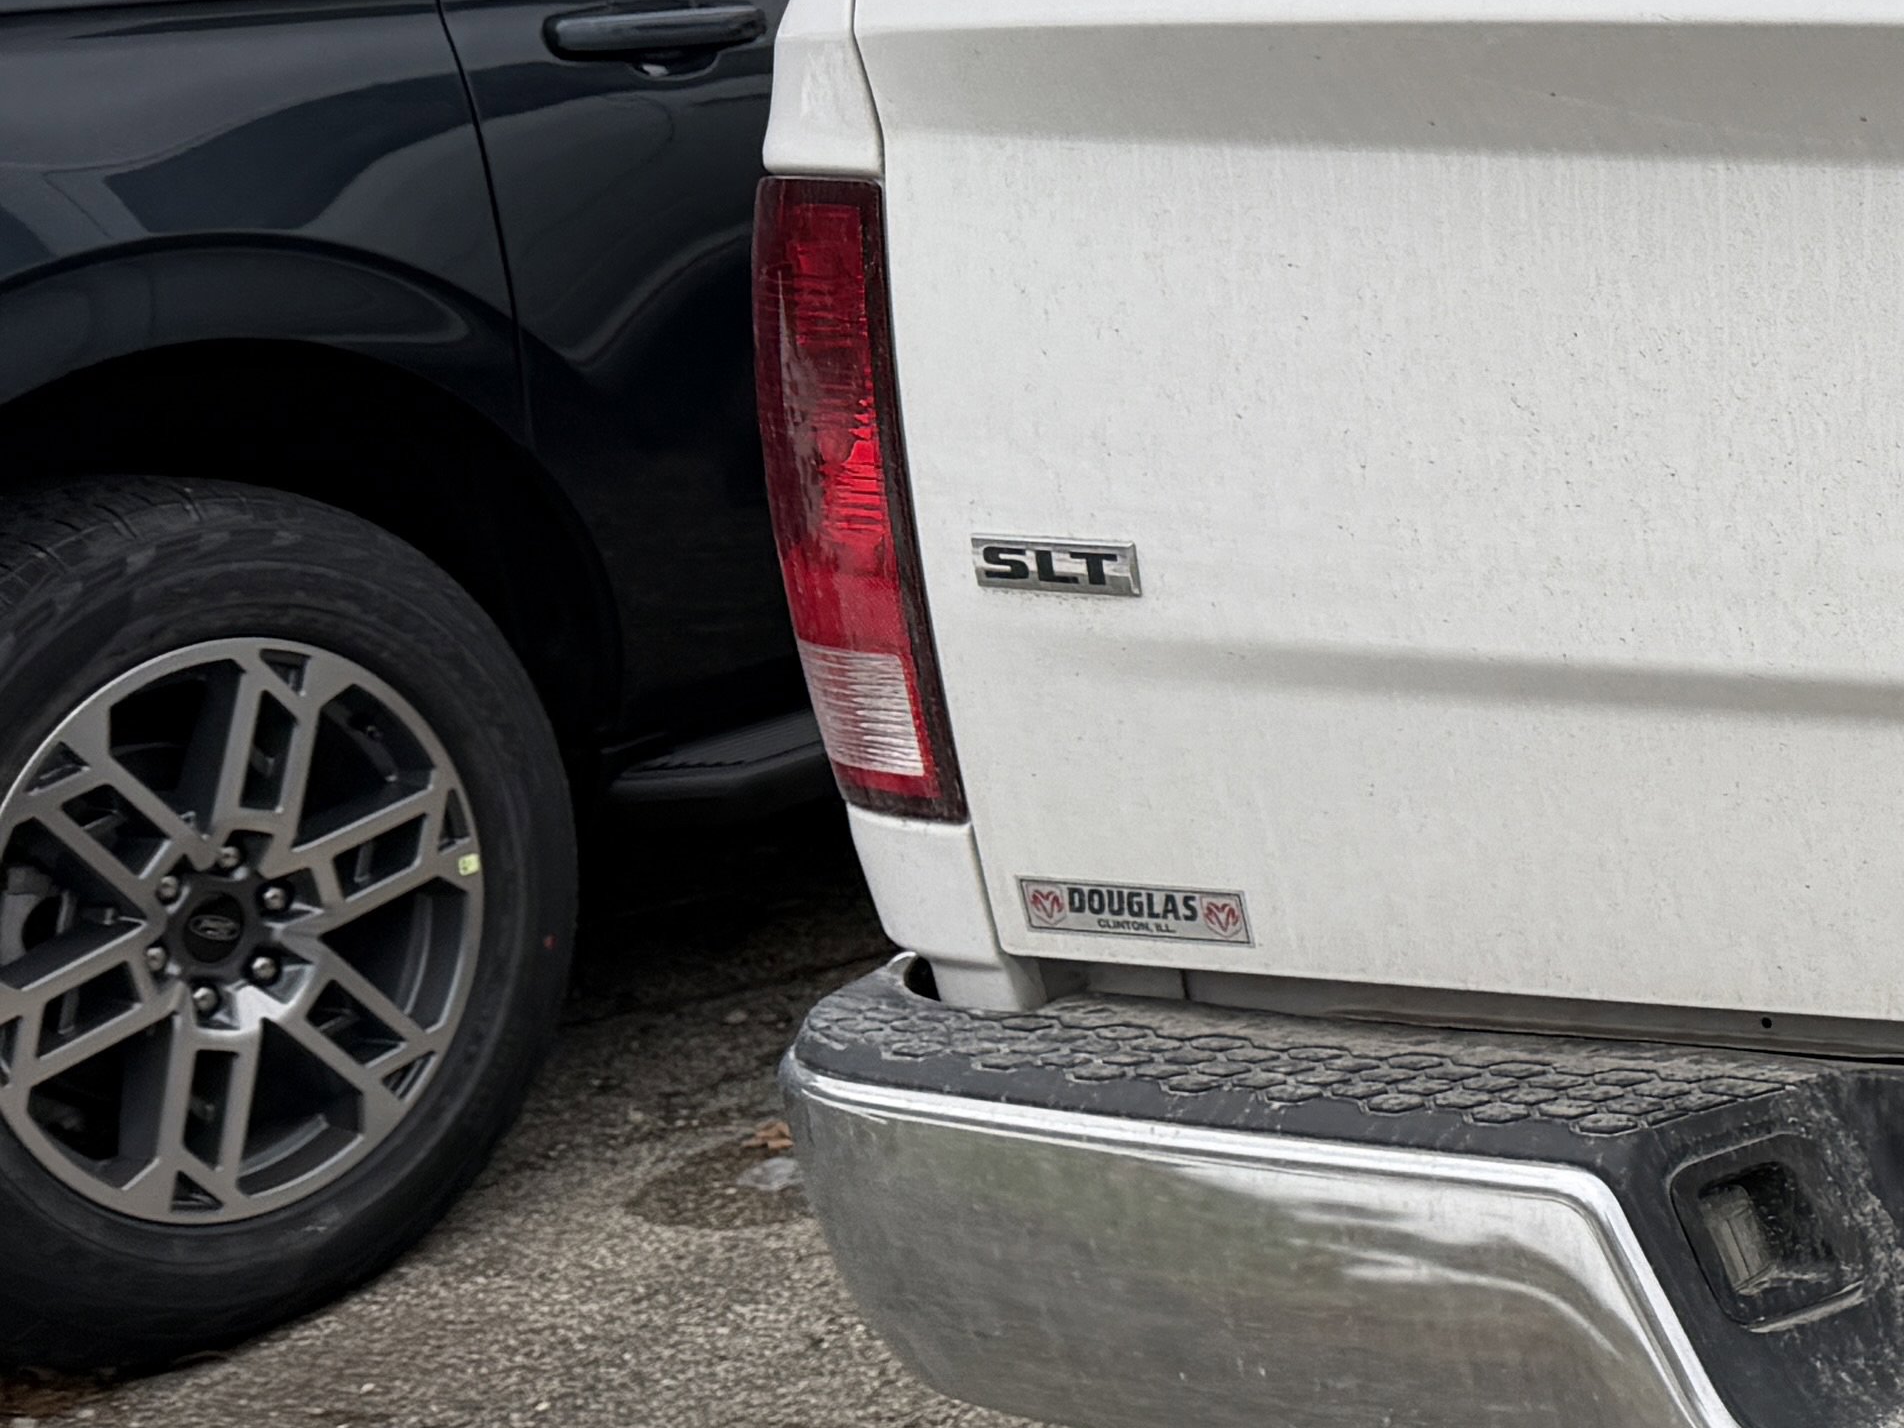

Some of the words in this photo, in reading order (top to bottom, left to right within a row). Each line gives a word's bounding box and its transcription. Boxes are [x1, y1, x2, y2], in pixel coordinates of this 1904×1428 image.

[982, 546, 1118, 585] SLT
[1067, 887, 1199, 922] DOUGLAS
[1097, 918, 1152, 933] CLINTON,
